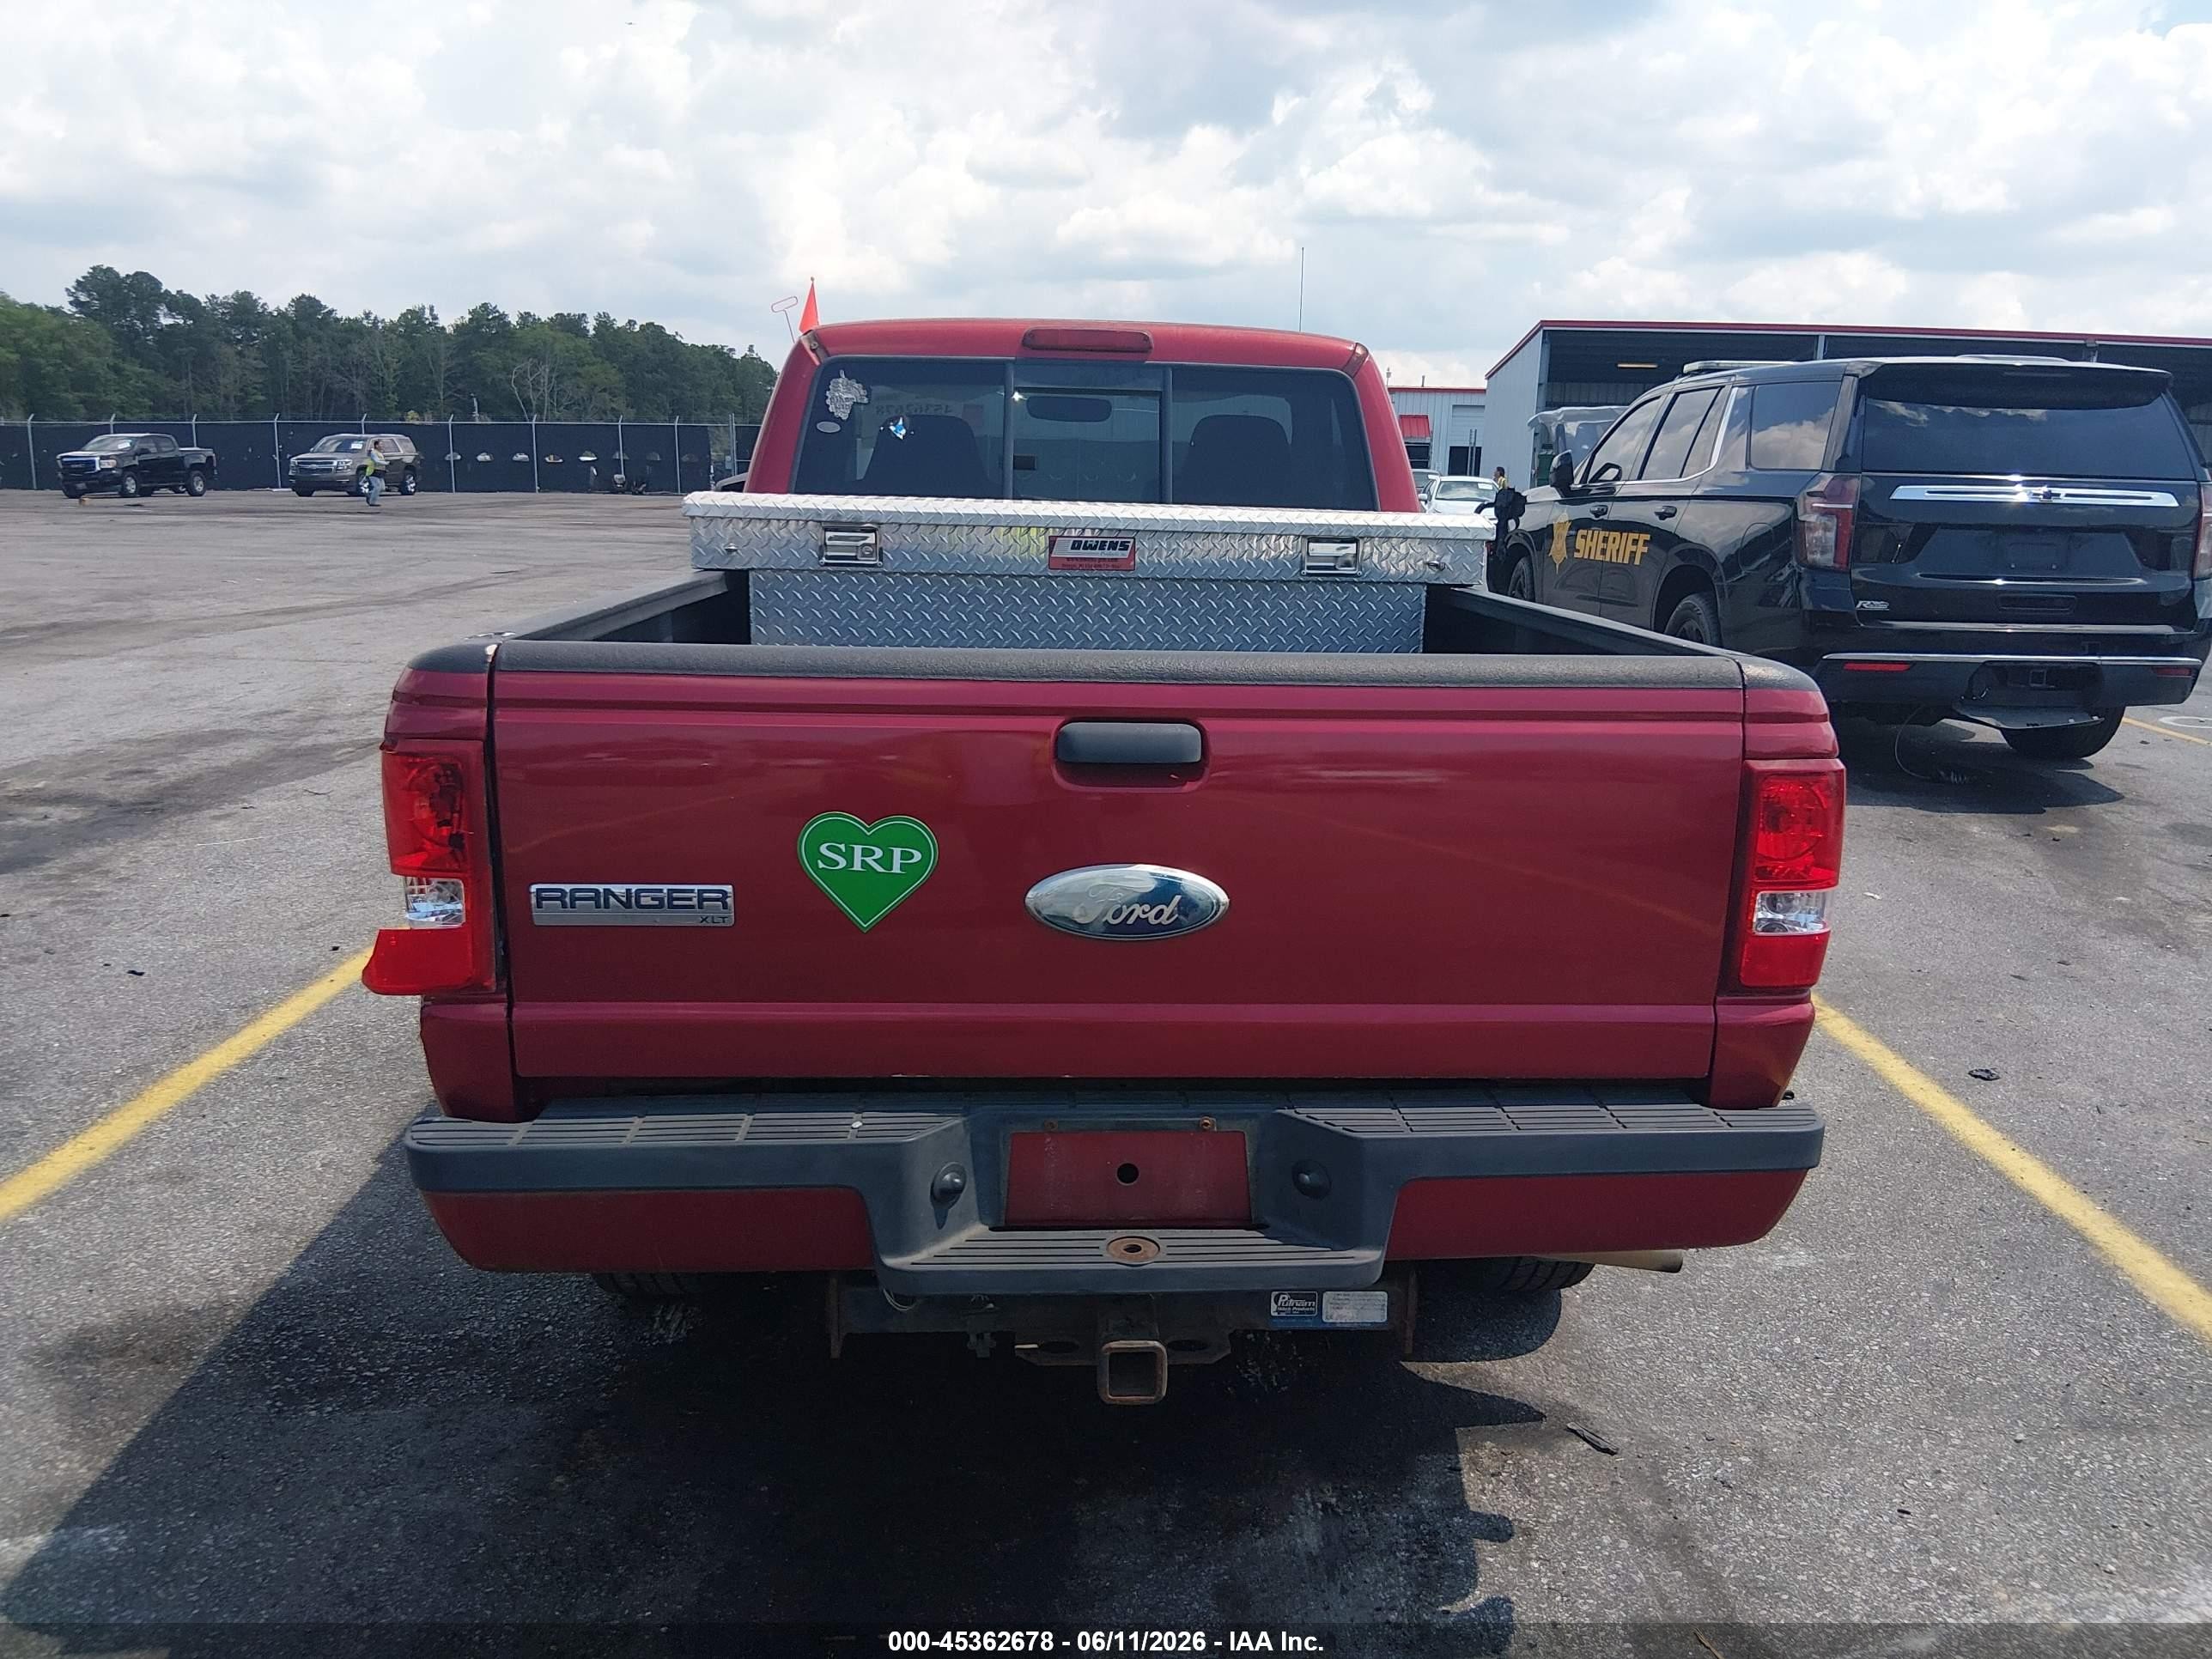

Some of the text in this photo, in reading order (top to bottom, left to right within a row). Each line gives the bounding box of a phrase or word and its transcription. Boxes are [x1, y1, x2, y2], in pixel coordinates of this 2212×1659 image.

[1070, 539, 1132, 551] OWENS
[1573, 529, 1650, 565] SHERIFF
[817, 842, 922, 874] SRP
[535, 888, 730, 910] RANGER
[1072, 871, 1182, 926] Ford
[700, 915, 729, 924] XLT
[1277, 1294, 1316, 1307] Putnam
